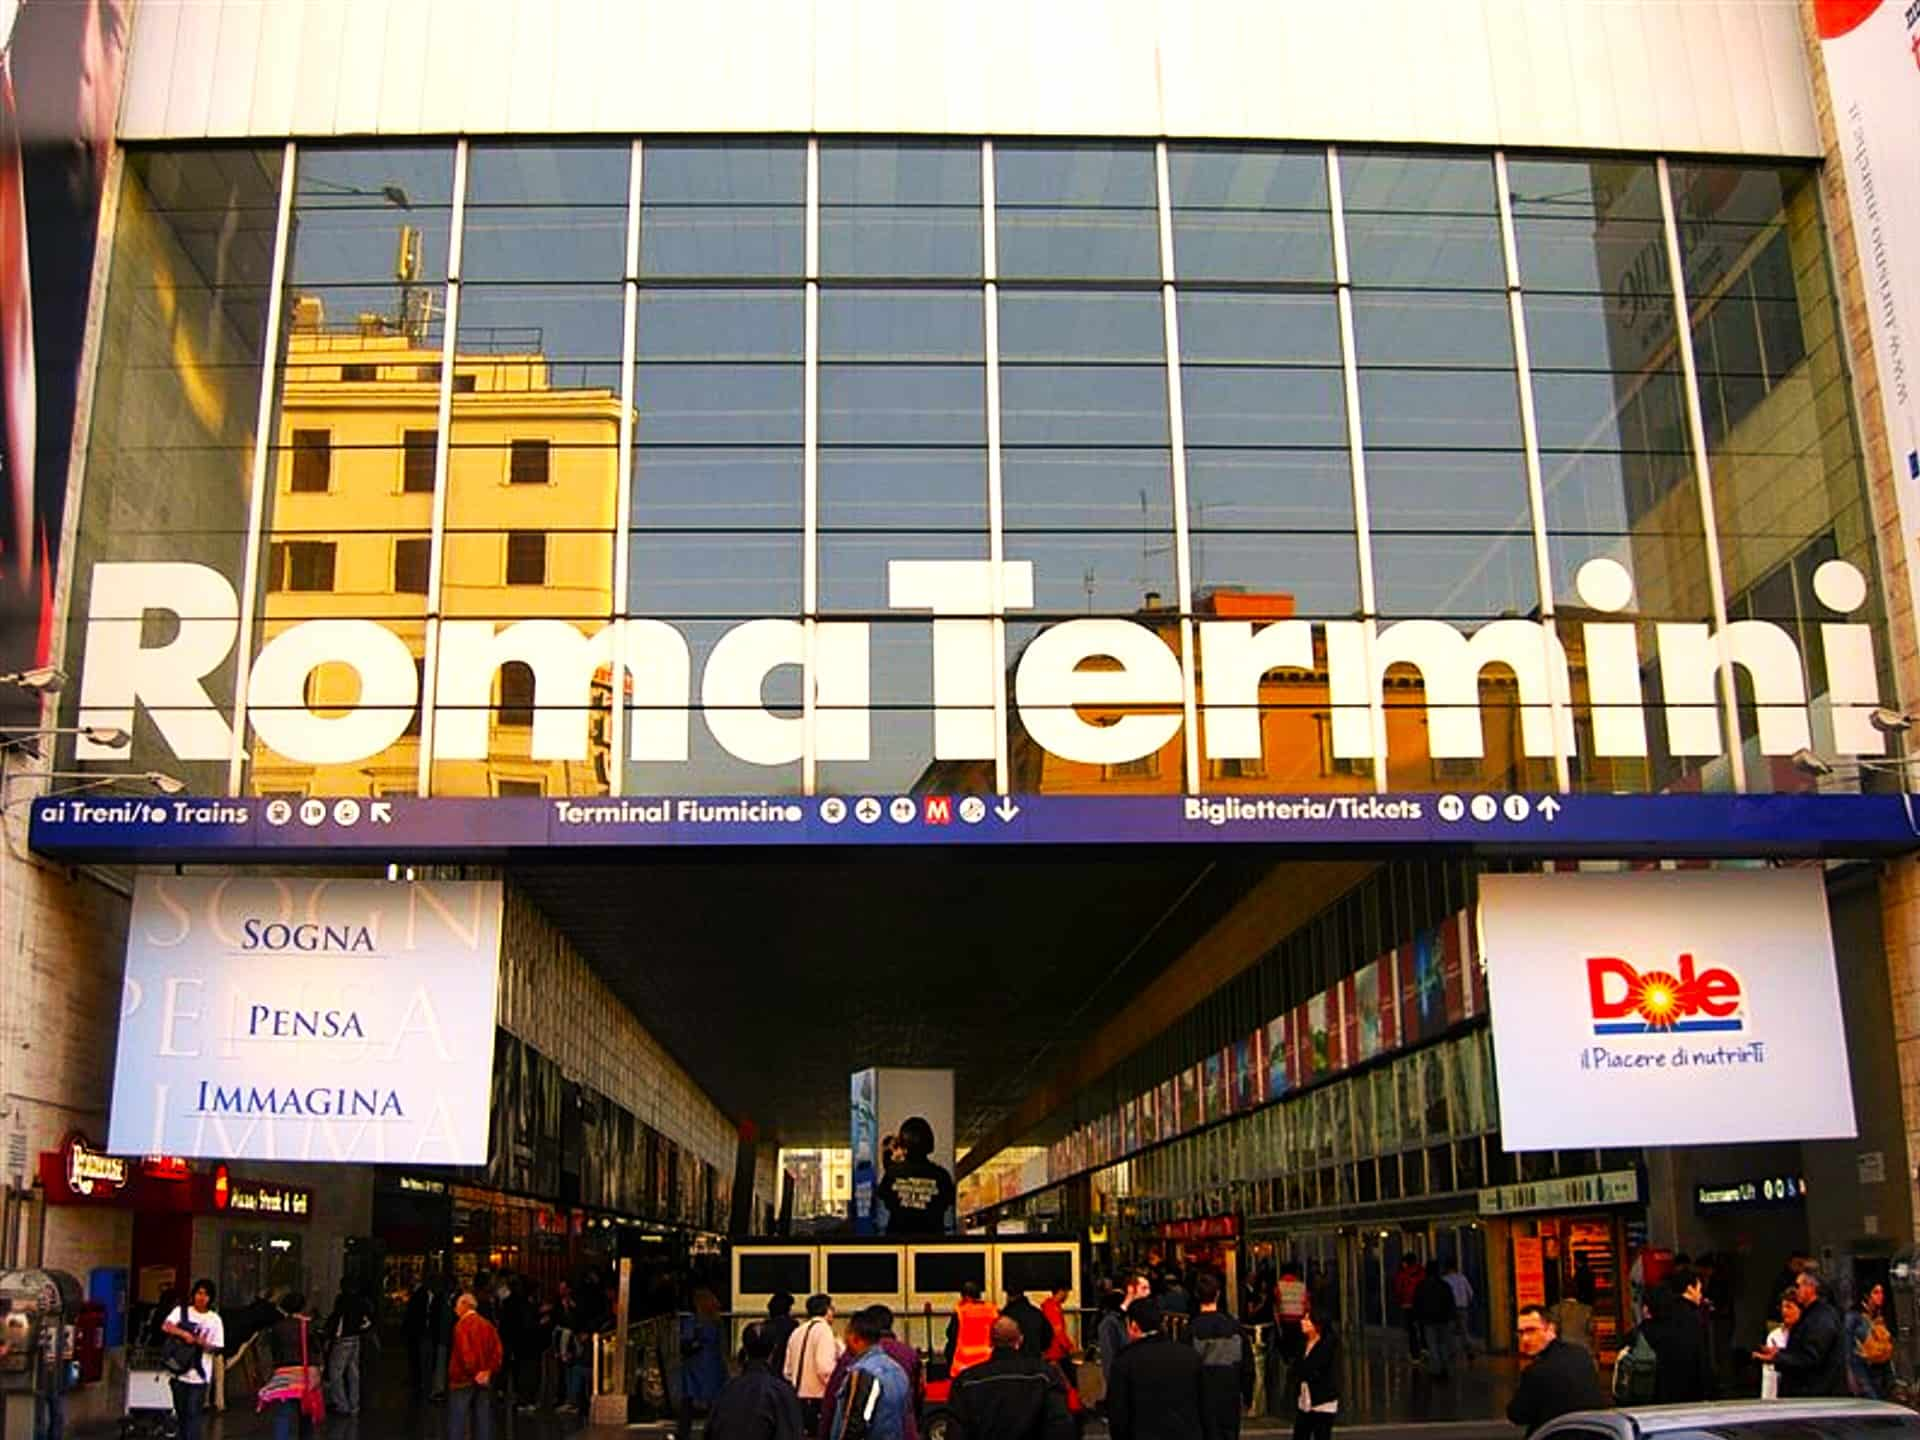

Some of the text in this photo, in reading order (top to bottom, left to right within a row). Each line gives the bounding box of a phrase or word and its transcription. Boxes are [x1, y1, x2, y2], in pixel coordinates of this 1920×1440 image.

[41, 802, 249, 824] ai Treni/to Trains
[555, 799, 804, 823] Terminal Fiumicino
[1184, 797, 1422, 825] Biglietteria/Tickets
[1586, 953, 1742, 1026] Dole
[1580, 1041, 1765, 1070] il Piacere di nutrirTi
